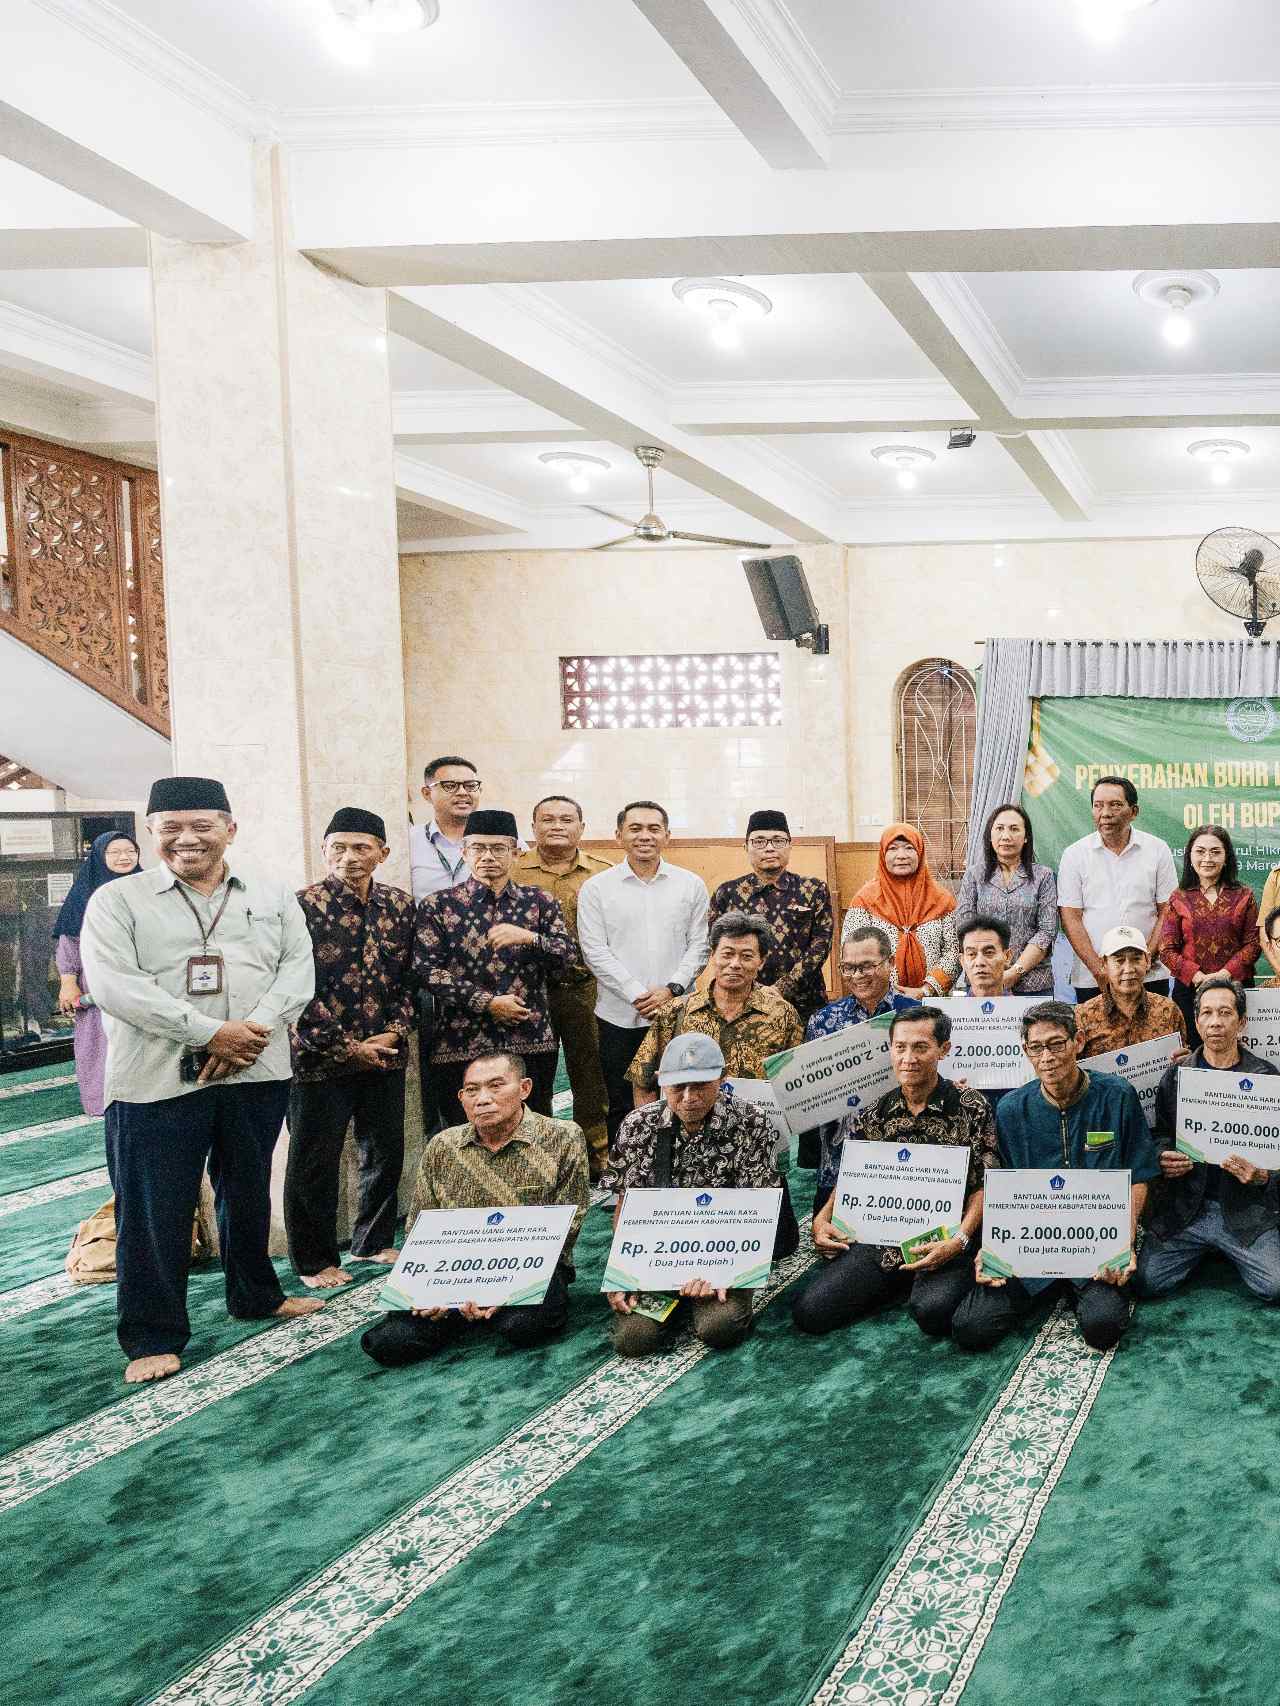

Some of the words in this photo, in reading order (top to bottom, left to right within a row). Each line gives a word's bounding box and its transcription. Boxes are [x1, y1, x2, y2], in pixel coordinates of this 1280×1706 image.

[1183, 802, 1235, 830] OLEH
[954, 1045, 1024, 1057] 2.000.000,
[784, 1050, 874, 1093] 2.000.000,00
[1185, 1119, 1206, 1134] Rp.
[1249, 1141, 1275, 1149] Rupiah
[842, 1194, 862, 1210] Rp.
[866, 1195, 952, 1214] 2.000.000,00
[882, 1215, 898, 1223] Juta
[900, 1216, 925, 1224] Rupiah
[991, 1227, 1015, 1243] Rp.
[1021, 1227, 1118, 1241] 2.000.000,00
[620, 1242, 648, 1258] Rp.
[654, 1240, 761, 1254] 2.000.000,00
[1042, 1247, 1059, 1255] Juta
[401, 1262, 429, 1277] Rp.
[434, 1256, 546, 1272] 2.000.000,00
[452, 1278, 474, 1286] Juta
[475, 1276, 508, 1284] Rupiah
